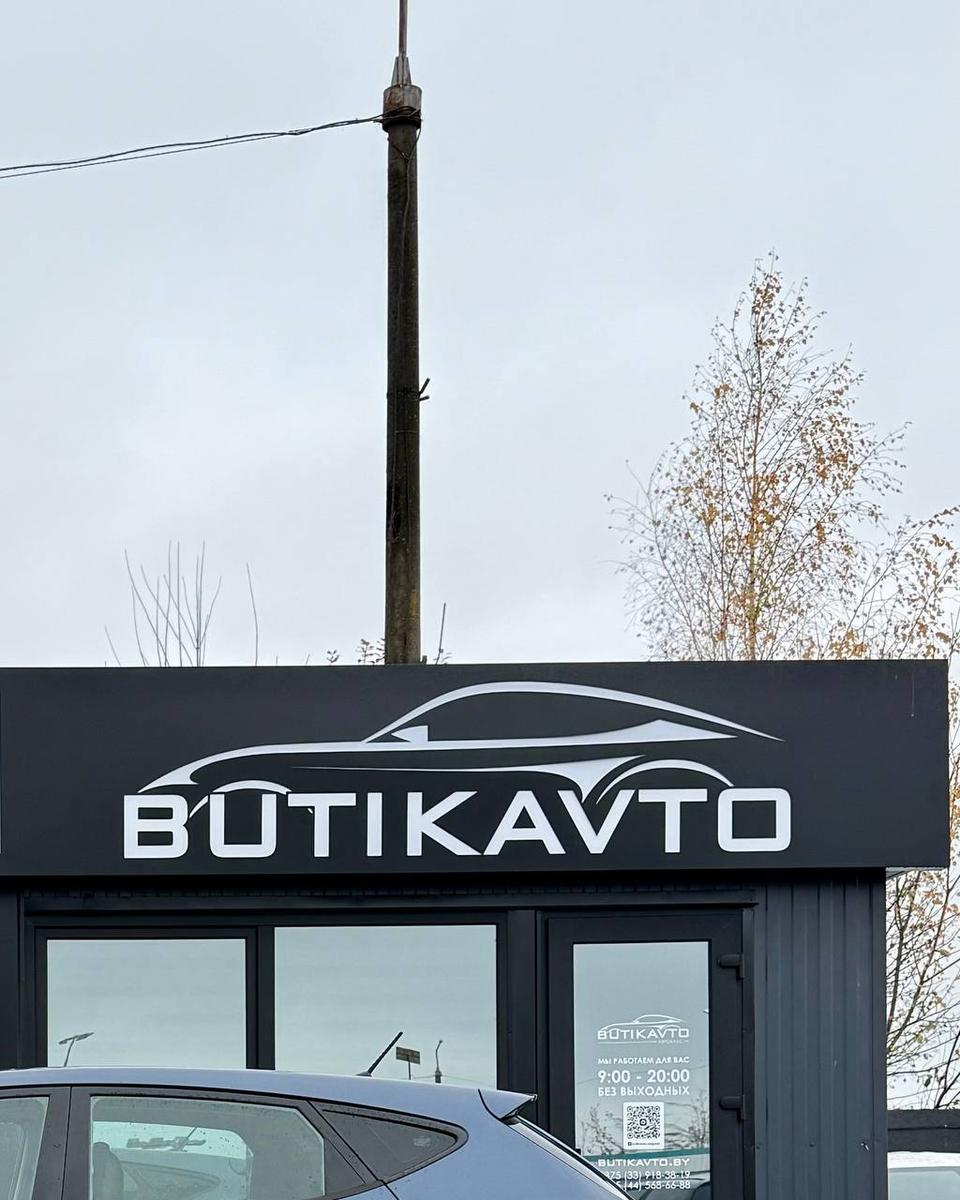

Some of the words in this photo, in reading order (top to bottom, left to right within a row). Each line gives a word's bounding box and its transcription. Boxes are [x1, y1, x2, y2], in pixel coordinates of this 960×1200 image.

[122, 786, 792, 860] BUTIKAVTO
[597, 1028, 689, 1040] BUTIKAVTO
[613, 1057, 654, 1065] РАБОТАЕМ
[655, 1056, 672, 1065] ДЛЯ
[597, 1070, 631, 1084] 9:00
[647, 1069, 690, 1083] 20:00
[598, 1086, 617, 1097] БЕЗ
[620, 1085, 690, 1097] ВЫХОДНЫХ
[597, 1158, 690, 1167] BUTIKAVTO.BY
[624, 1170, 642, 1182] (33)
[644, 1170, 691, 1180] 918-38-19
[624, 1180, 642, 1191] (44)
[644, 1180, 691, 1190] 568-66-88
